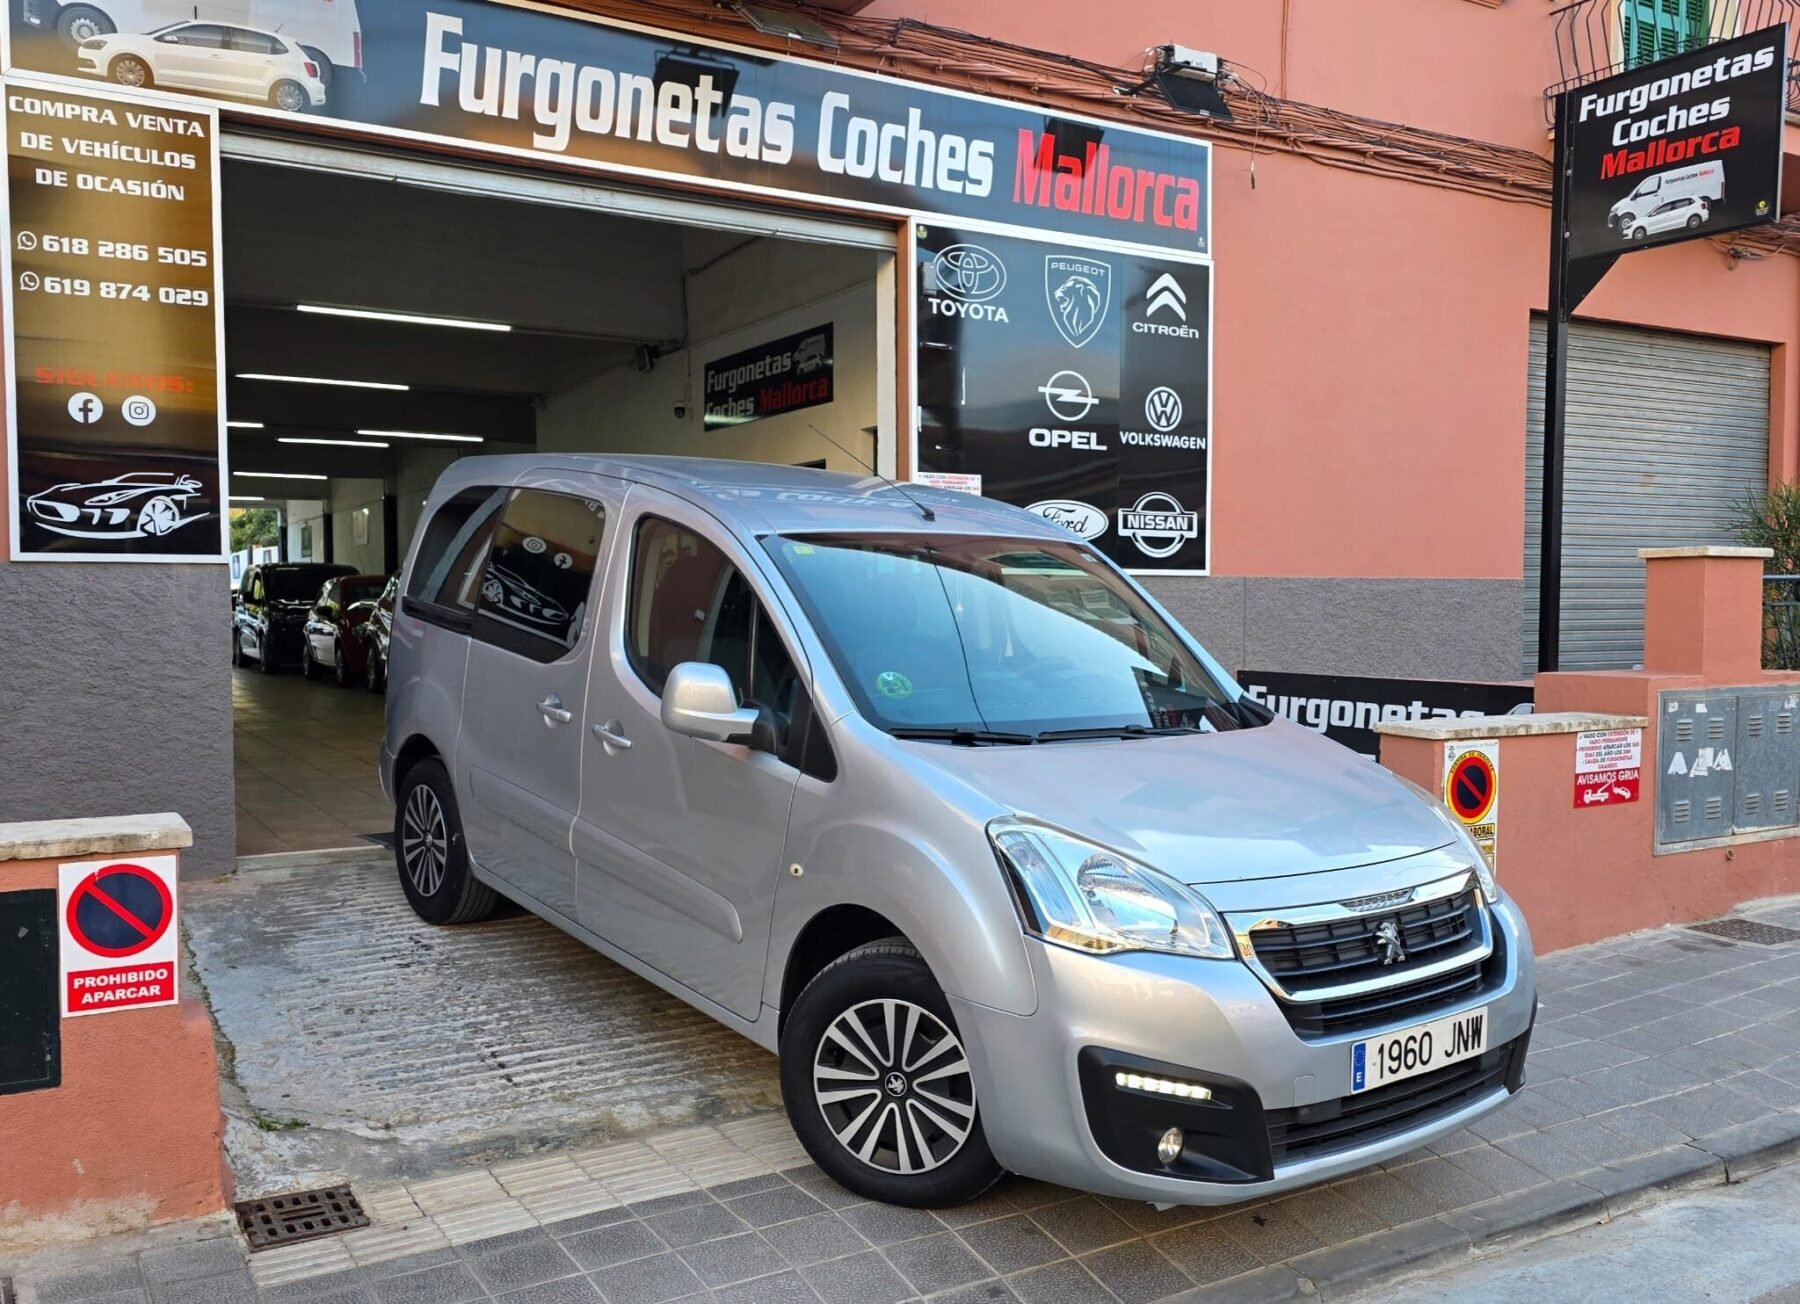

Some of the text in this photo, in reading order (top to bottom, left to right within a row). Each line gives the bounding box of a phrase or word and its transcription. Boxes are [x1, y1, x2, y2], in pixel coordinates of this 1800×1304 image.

[1578, 46, 1775, 122] Furgonetas
[9, 96, 205, 138] COMPRA VENTA
[420, 11, 1201, 231] Furgonetas Coches Mallorca
[1611, 97, 1731, 147] Coches
[20, 132, 196, 170] DE VEHÍCULOS
[1600, 126, 1741, 179] Mallorca
[35, 168, 185, 201] DE OCASIÓN
[42, 235, 208, 267] 618 286 505
[1051, 262, 1106, 277] PEUGEOT
[44, 277, 209, 306] 619 874 029
[927, 297, 1009, 324] TOYOTA
[706, 352, 792, 394] Furgonetas
[759, 377, 829, 413] Mallorca
[1028, 428, 1108, 451] OPEL
[1120, 430, 1207, 450] VOLKSWAGEN
[1127, 514, 1189, 531] NISSAN
[1576, 769, 1639, 786] AVISAMOS GRUA
[73, 968, 168, 989] PROHIBIDO
[81, 984, 161, 1005] APARCAR
[1377, 1014, 1484, 1080] 1960 JNW
[1356, 1071, 1363, 1083] E
